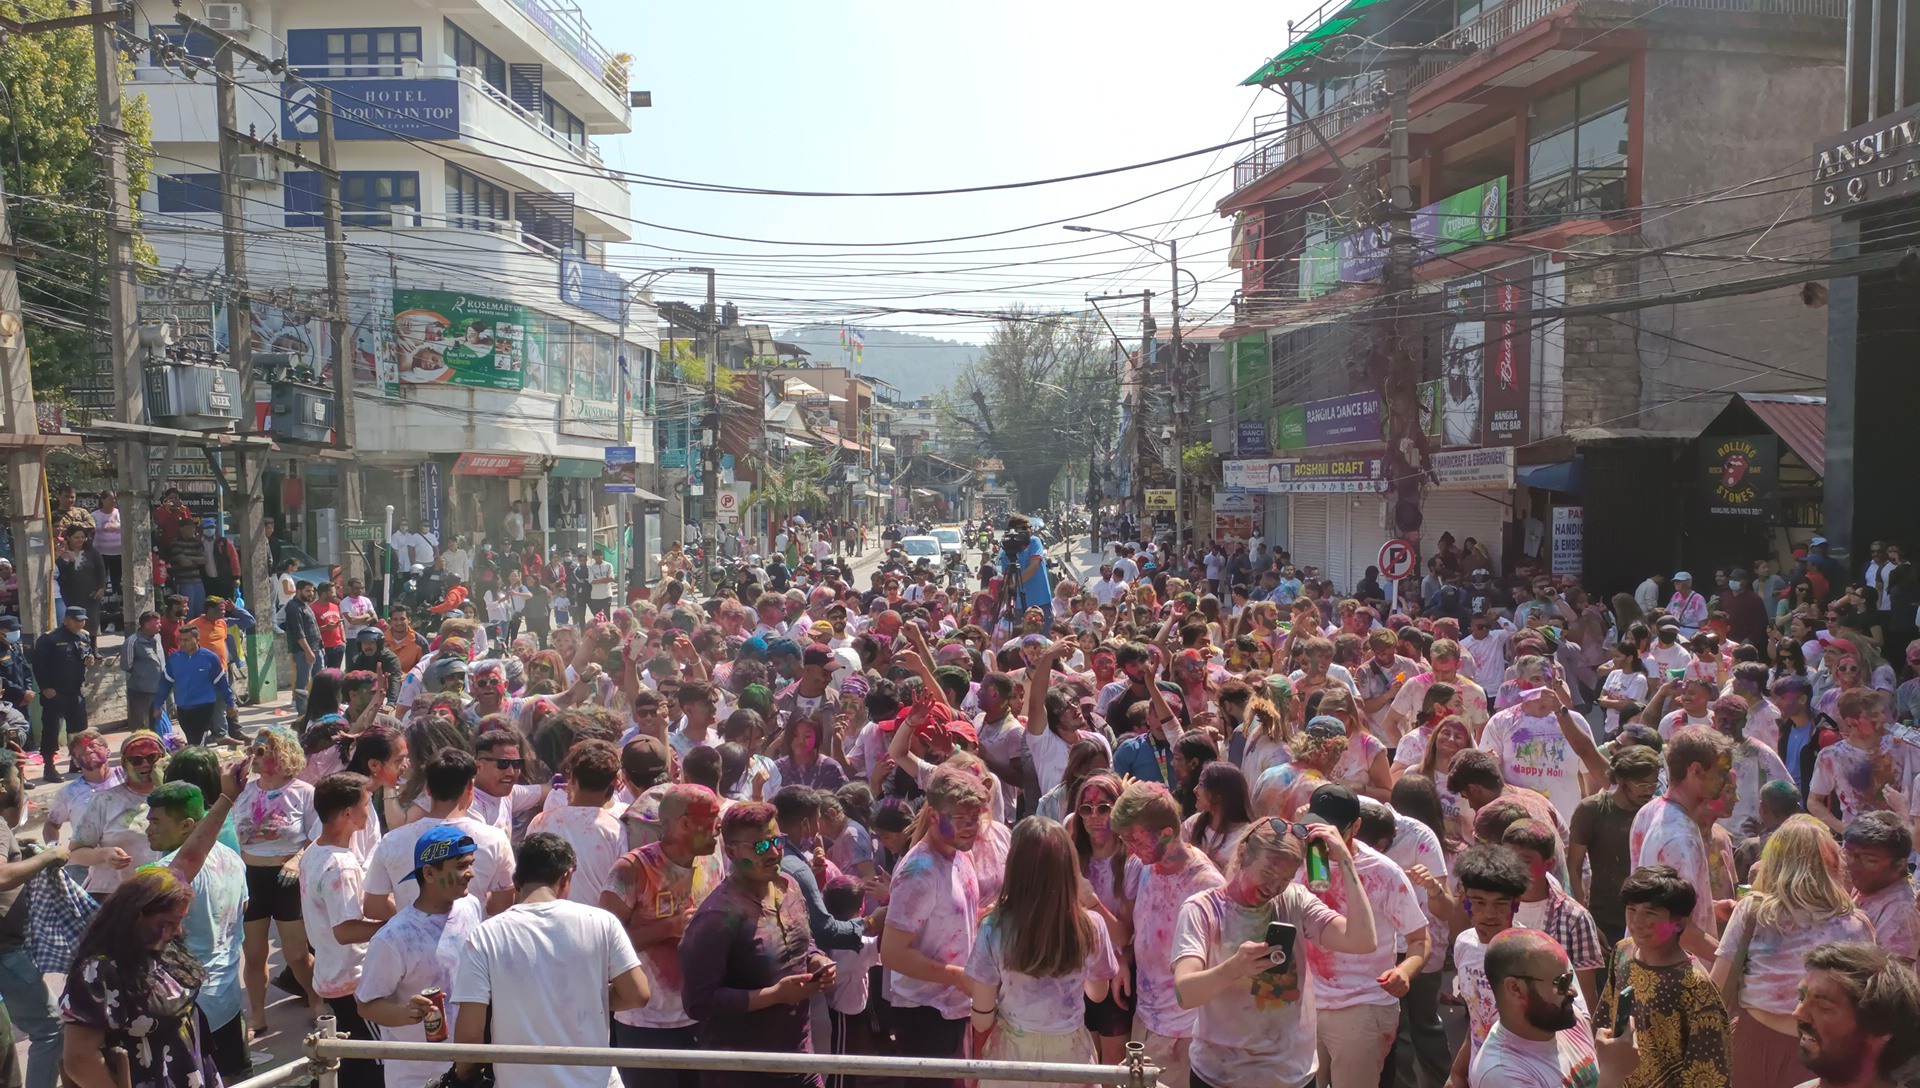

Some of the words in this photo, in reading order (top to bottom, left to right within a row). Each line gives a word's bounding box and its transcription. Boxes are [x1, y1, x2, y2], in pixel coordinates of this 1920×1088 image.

[365, 90, 427, 101] HOTEL
[340, 107, 419, 120] MOUNTAIN
[421, 107, 453, 119] TOP
[1447, 211, 1476, 232] TUBORG
[467, 300, 513, 312] ROSEMARY
[1306, 407, 1336, 424] RANGILA
[1337, 402, 1361, 421] DANCE
[1490, 421, 1509, 431] DANCE
[1509, 420, 1521, 430] BAR
[1717, 441, 1757, 459] ROLLING
[470, 457, 488, 467] ARTS
[487, 459, 496, 467] OF
[1294, 462, 1329, 476] ROSHNI
[1331, 461, 1364, 475] CRAFT
[149, 464, 178, 475] HOEL
[1716, 484, 1755, 503] STONES
[430, 464, 441, 540] ALTITUD
[347, 528, 369, 538] Street
[370, 527, 382, 540] 16
[1512, 764, 1543, 777] Happy
